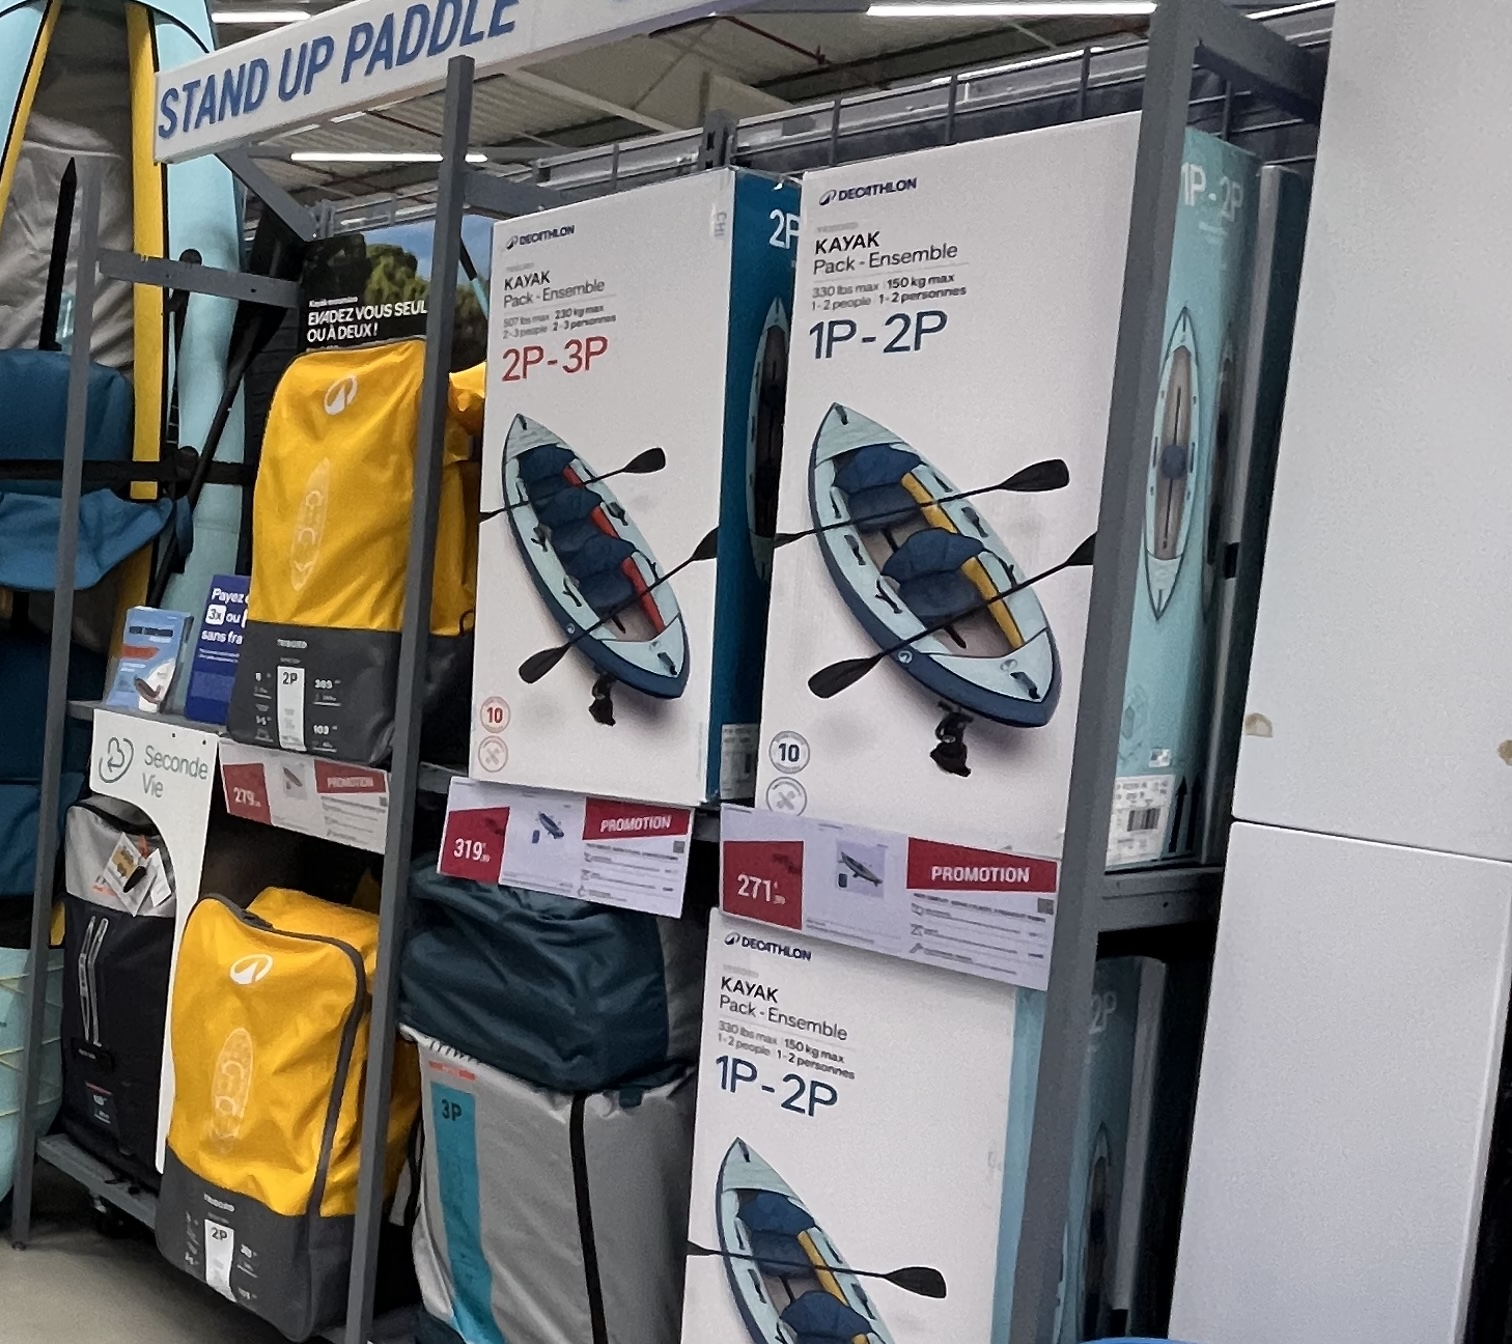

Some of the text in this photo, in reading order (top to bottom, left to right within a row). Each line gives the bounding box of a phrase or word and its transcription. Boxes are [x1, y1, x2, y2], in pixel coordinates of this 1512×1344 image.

[158, 58, 270, 140] STAND
[278, 36, 334, 103] UP
[838, 177, 918, 201] DECATHLON
[519, 225, 575, 245] DECATHLON
[815, 231, 880, 255] KAYAK
[813, 256, 855, 275] Pack
[869, 243, 957, 268] Ensemble
[504, 270, 550, 291] KAYAK
[812, 286, 835, 298] 330
[855, 283, 879, 293] max
[888, 277, 908, 289] 150
[911, 276, 926, 288] kg
[928, 274, 955, 284] max
[504, 292, 533, 308] Pack
[543, 279, 605, 301] Ensemble
[832, 297, 871, 311] people
[901, 286, 967, 303] personnes
[308, 308, 354, 326] EVADEZ
[355, 303, 392, 320] VOUS
[307, 328, 326, 342] OU
[338, 324, 372, 340] DEUX
[810, 319, 856, 359] 1P
[883, 310, 947, 353] 2P
[502, 346, 544, 381] 2P
[563, 336, 608, 373] 3P
[212, 588, 245, 604] Payez
[208, 609, 241, 623] 3x ou
[201, 630, 243, 645] sans fra
[282, 672, 298, 685] 2P
[486, 707, 503, 724] 10
[144, 745, 208, 780] Seconde
[778, 743, 800, 762] 10
[143, 772, 163, 798] Vie
[327, 776, 374, 788] PROMOTION
[600, 814, 672, 833] PROMOTION
[931, 866, 1030, 883] PROMOTION
[741, 936, 812, 961] DECATHLON
[721, 976, 778, 1003] KAYAK
[720, 994, 756, 1018] Pack
[768, 1006, 848, 1041] Ensemble
[736, 1041, 771, 1056] people
[797, 1056, 855, 1079] personnes
[784, 1038, 802, 1052] 150
[805, 1043, 819, 1059] kg
[821, 1050, 844, 1064] max
[716, 1055, 757, 1093] 1P
[781, 1073, 837, 1117] 2P
[441, 1099, 462, 1121] 3P
[211, 1227, 228, 1241] 2P
